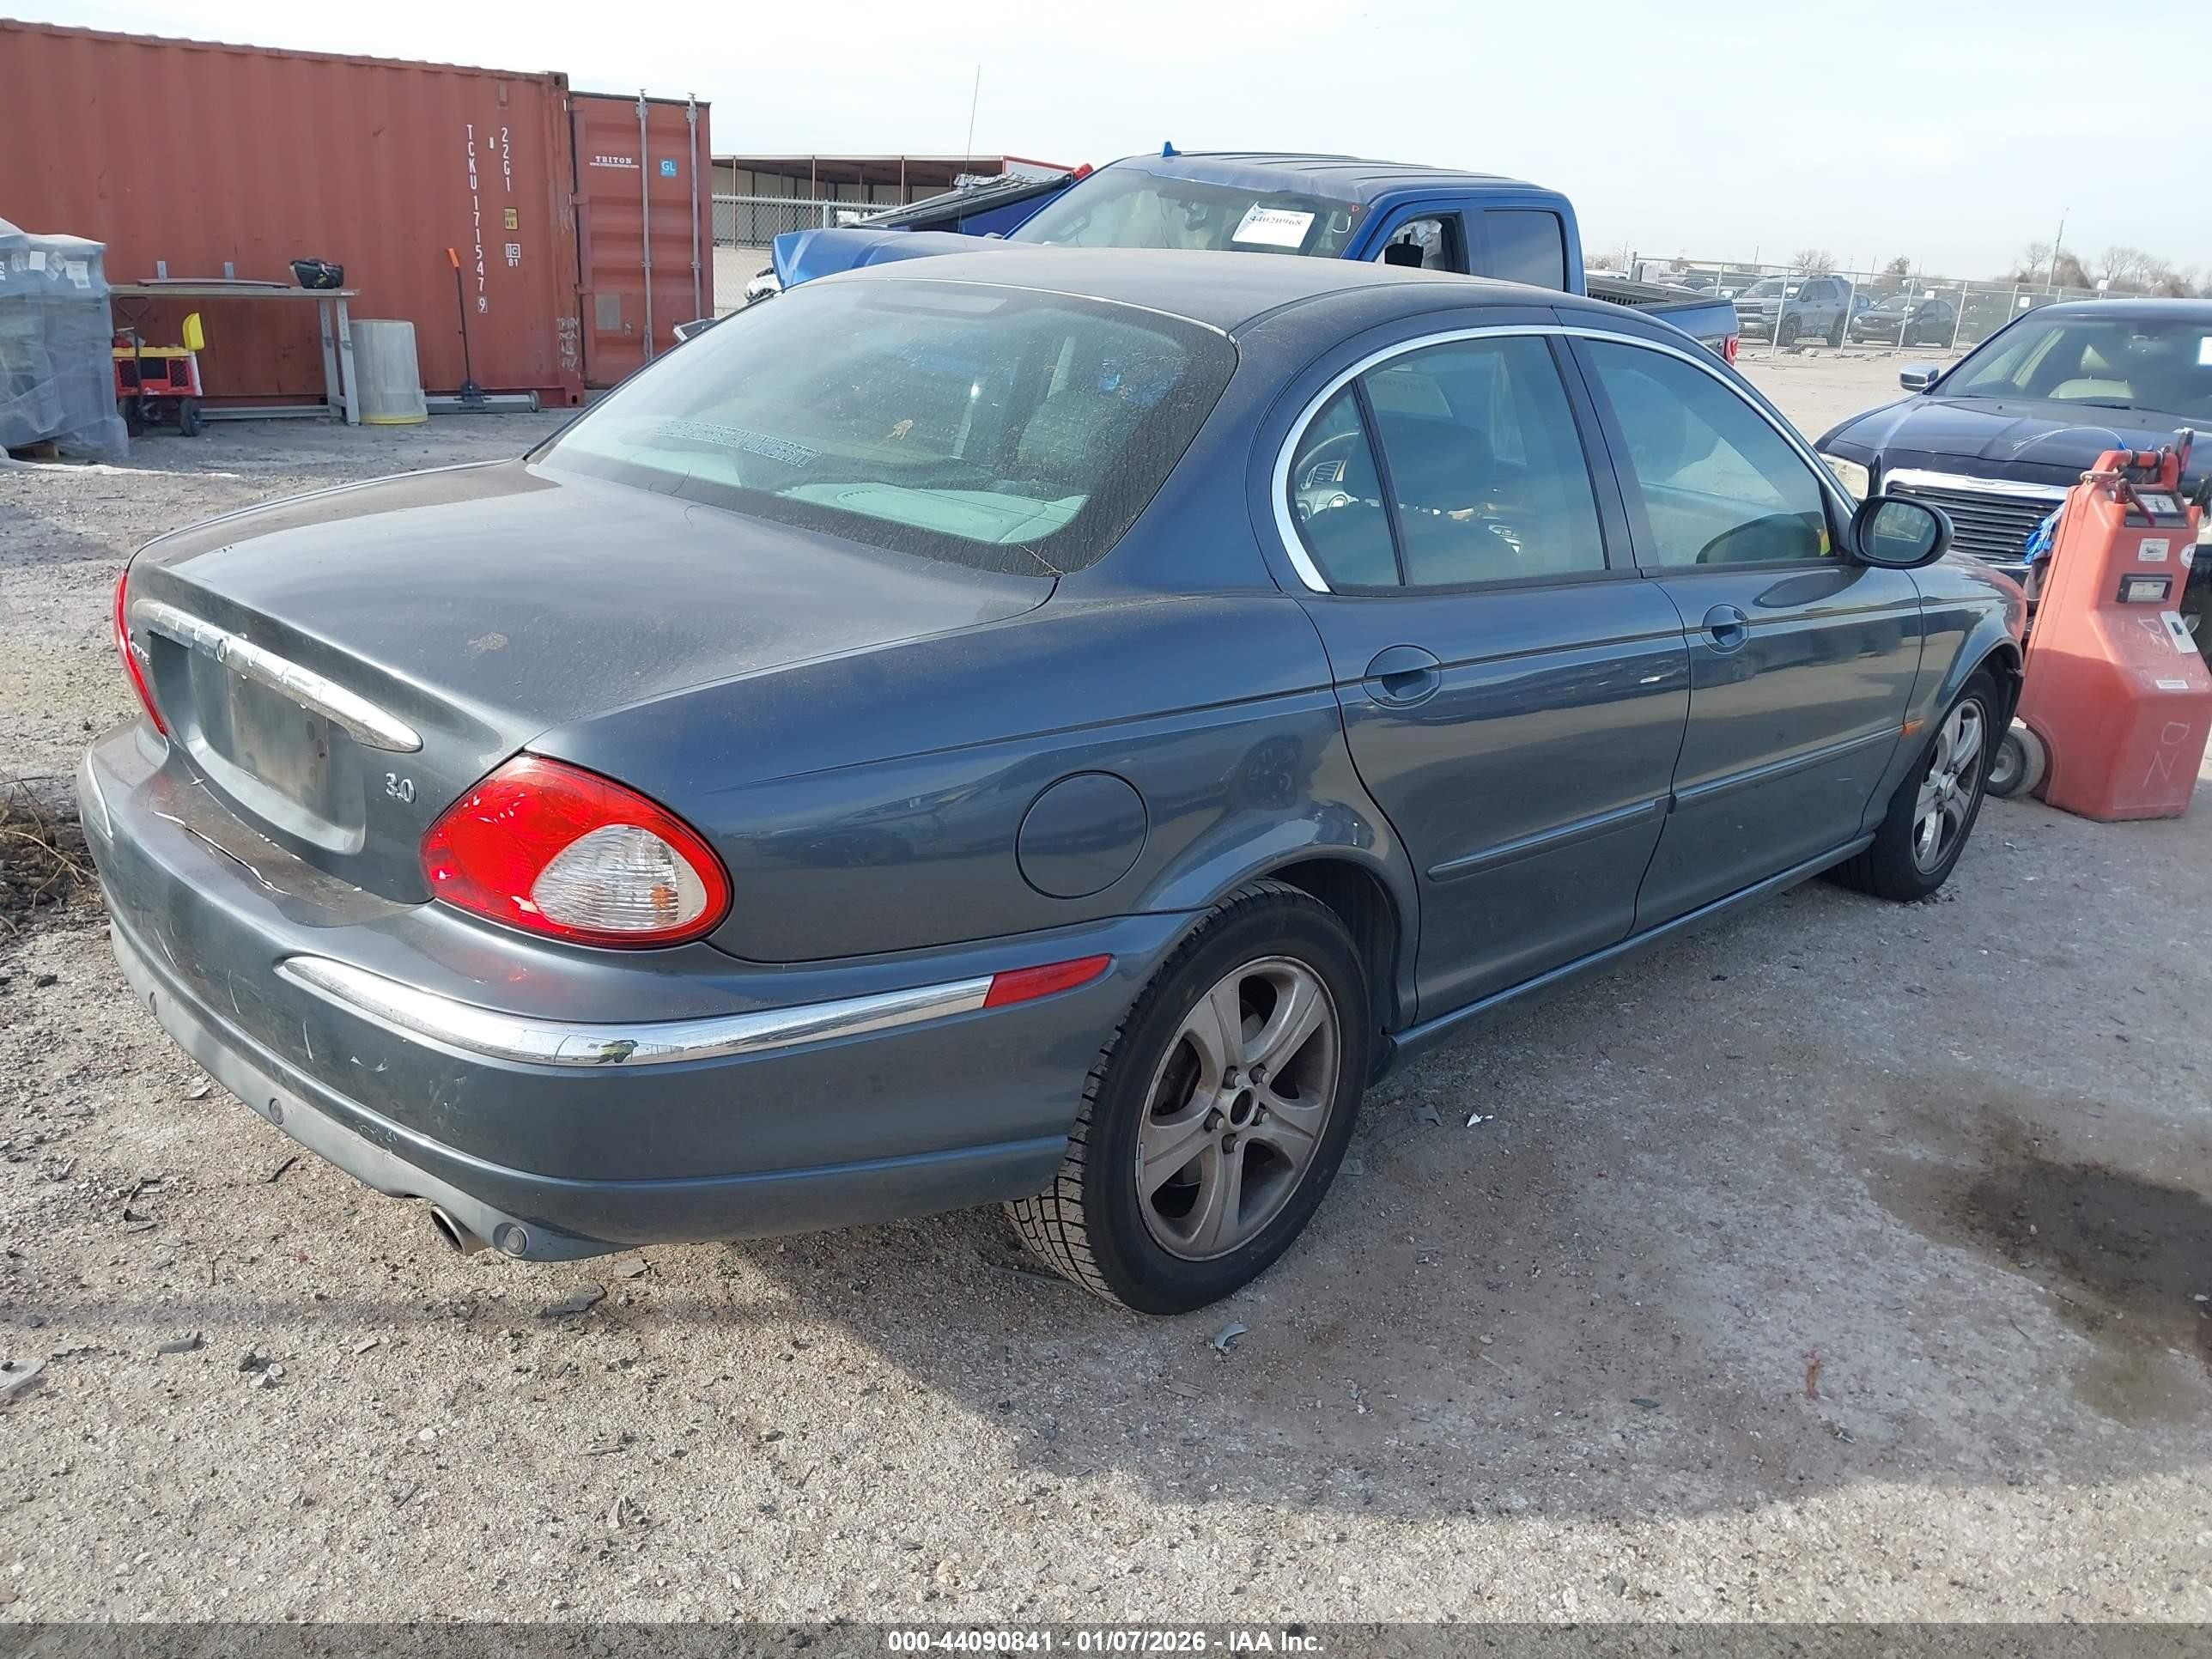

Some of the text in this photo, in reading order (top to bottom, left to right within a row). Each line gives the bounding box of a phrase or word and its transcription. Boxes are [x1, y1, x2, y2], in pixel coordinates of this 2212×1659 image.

[501, 127, 511, 191] 22G1
[595, 155, 633, 164] TRITON
[660, 161, 676, 172] GL
[467, 125, 478, 190] TCKU
[474, 195, 484, 292] 171547
[743, 432, 823, 468] UNIVERSITY
[386, 772, 416, 804] 3.0
